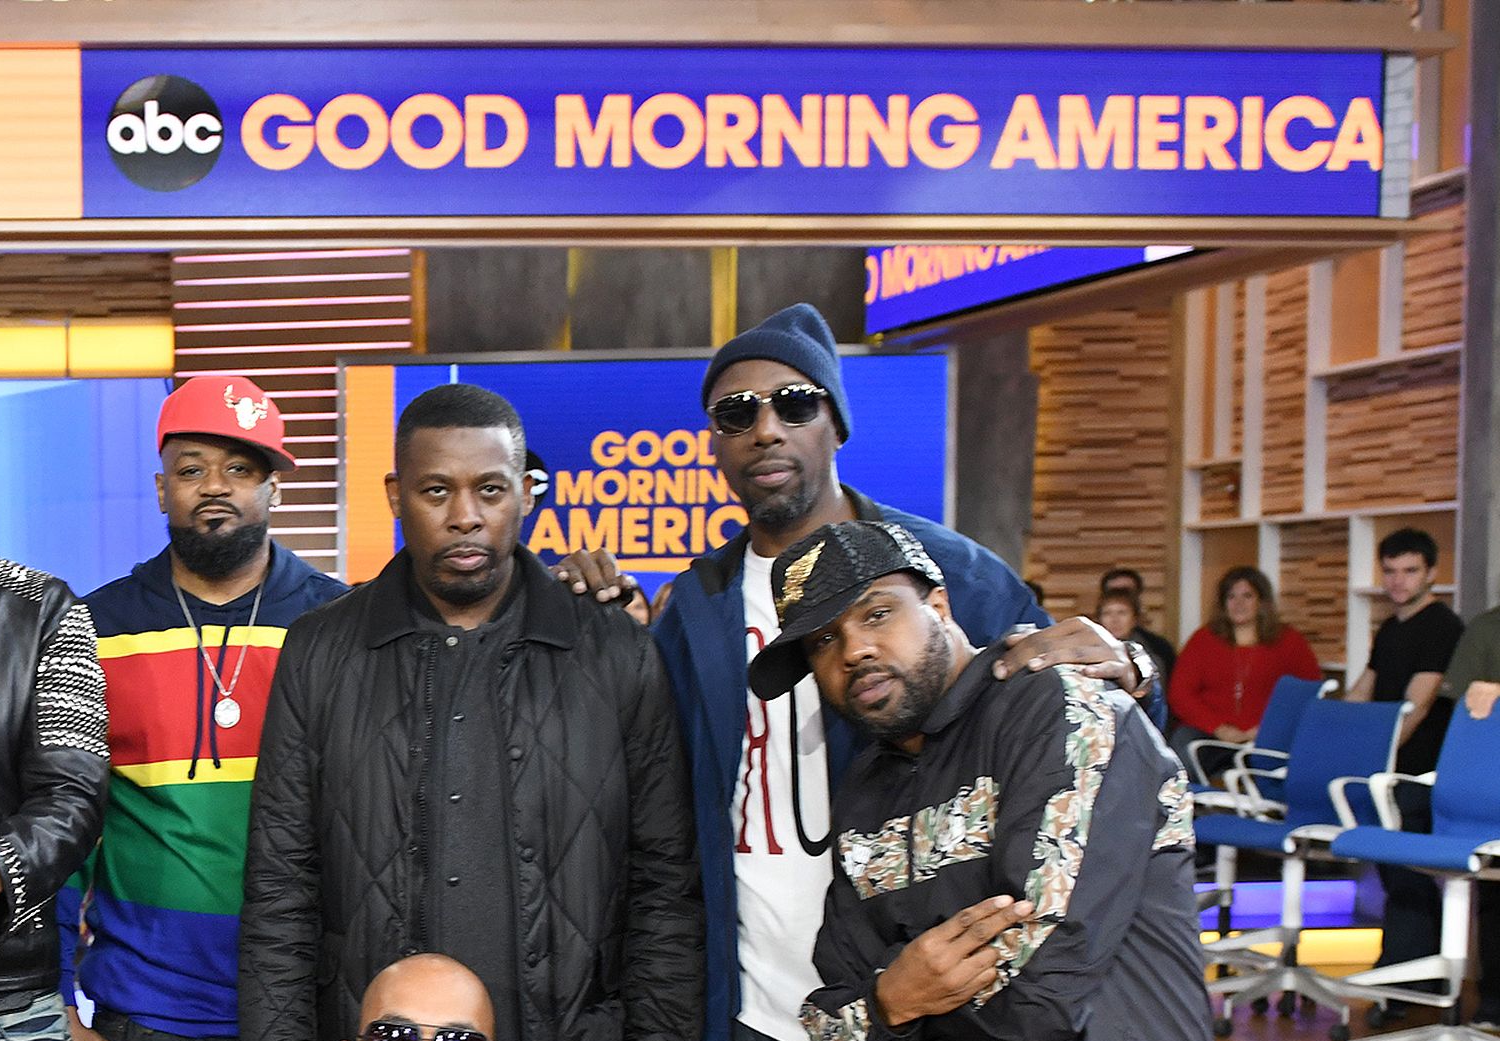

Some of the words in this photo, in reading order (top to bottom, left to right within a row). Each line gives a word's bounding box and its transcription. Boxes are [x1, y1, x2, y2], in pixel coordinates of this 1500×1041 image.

[106, 101, 223, 155] abc
[240, 93, 528, 170] GOOD
[555, 93, 980, 170] MORNING
[990, 95, 1383, 172] AMERICA
[555, 470, 742, 506] MORNIN
[527, 505, 750, 555] AMERIC
